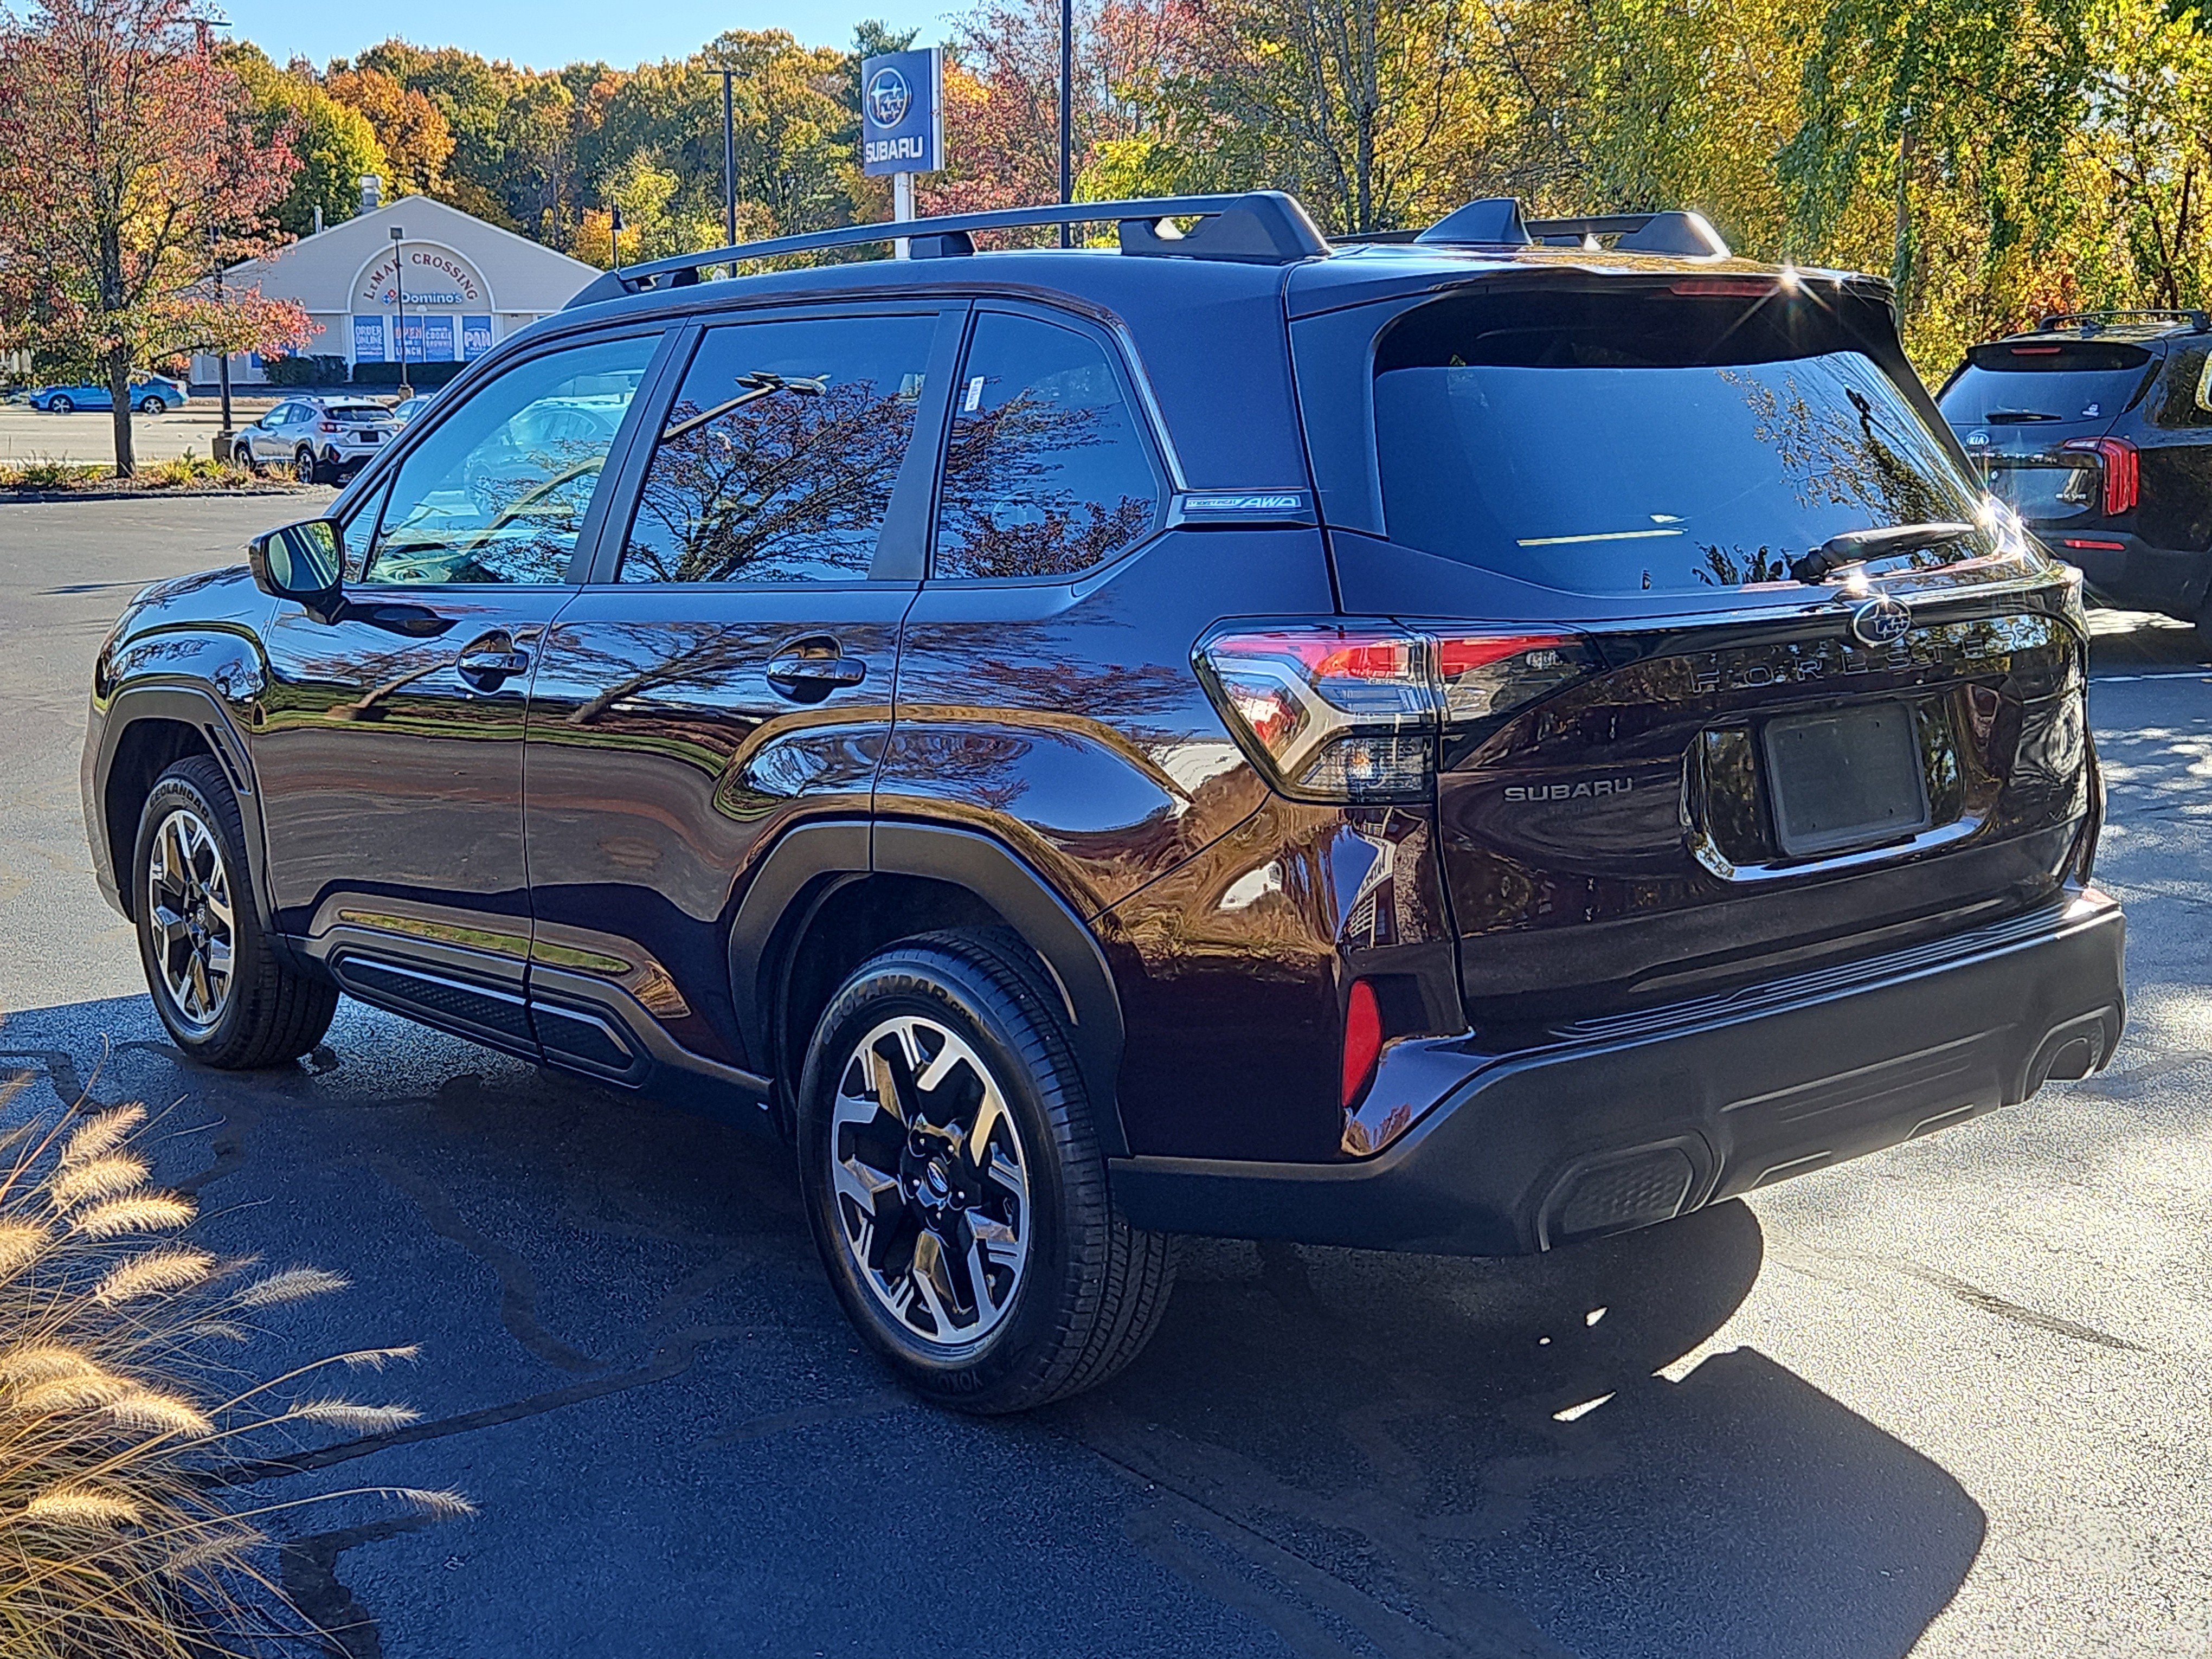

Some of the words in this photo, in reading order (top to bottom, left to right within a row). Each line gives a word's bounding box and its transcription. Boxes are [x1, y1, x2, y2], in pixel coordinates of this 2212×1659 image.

[865, 136, 923, 163] SUBARU
[411, 253, 478, 300] CROSSING
[401, 291, 462, 304] Domino's
[355, 325, 382, 336] ORDER
[395, 326, 422, 340] OPEN
[356, 335, 382, 345] ONLINE
[464, 331, 491, 348] PAN
[1969, 435, 1985, 445] KIA
[1239, 497, 1297, 509] AWD
[1504, 777, 1633, 802] SUBARU
[149, 782, 209, 819] GEOLANDAR
[822, 974, 948, 1045] GEOLANDAR
